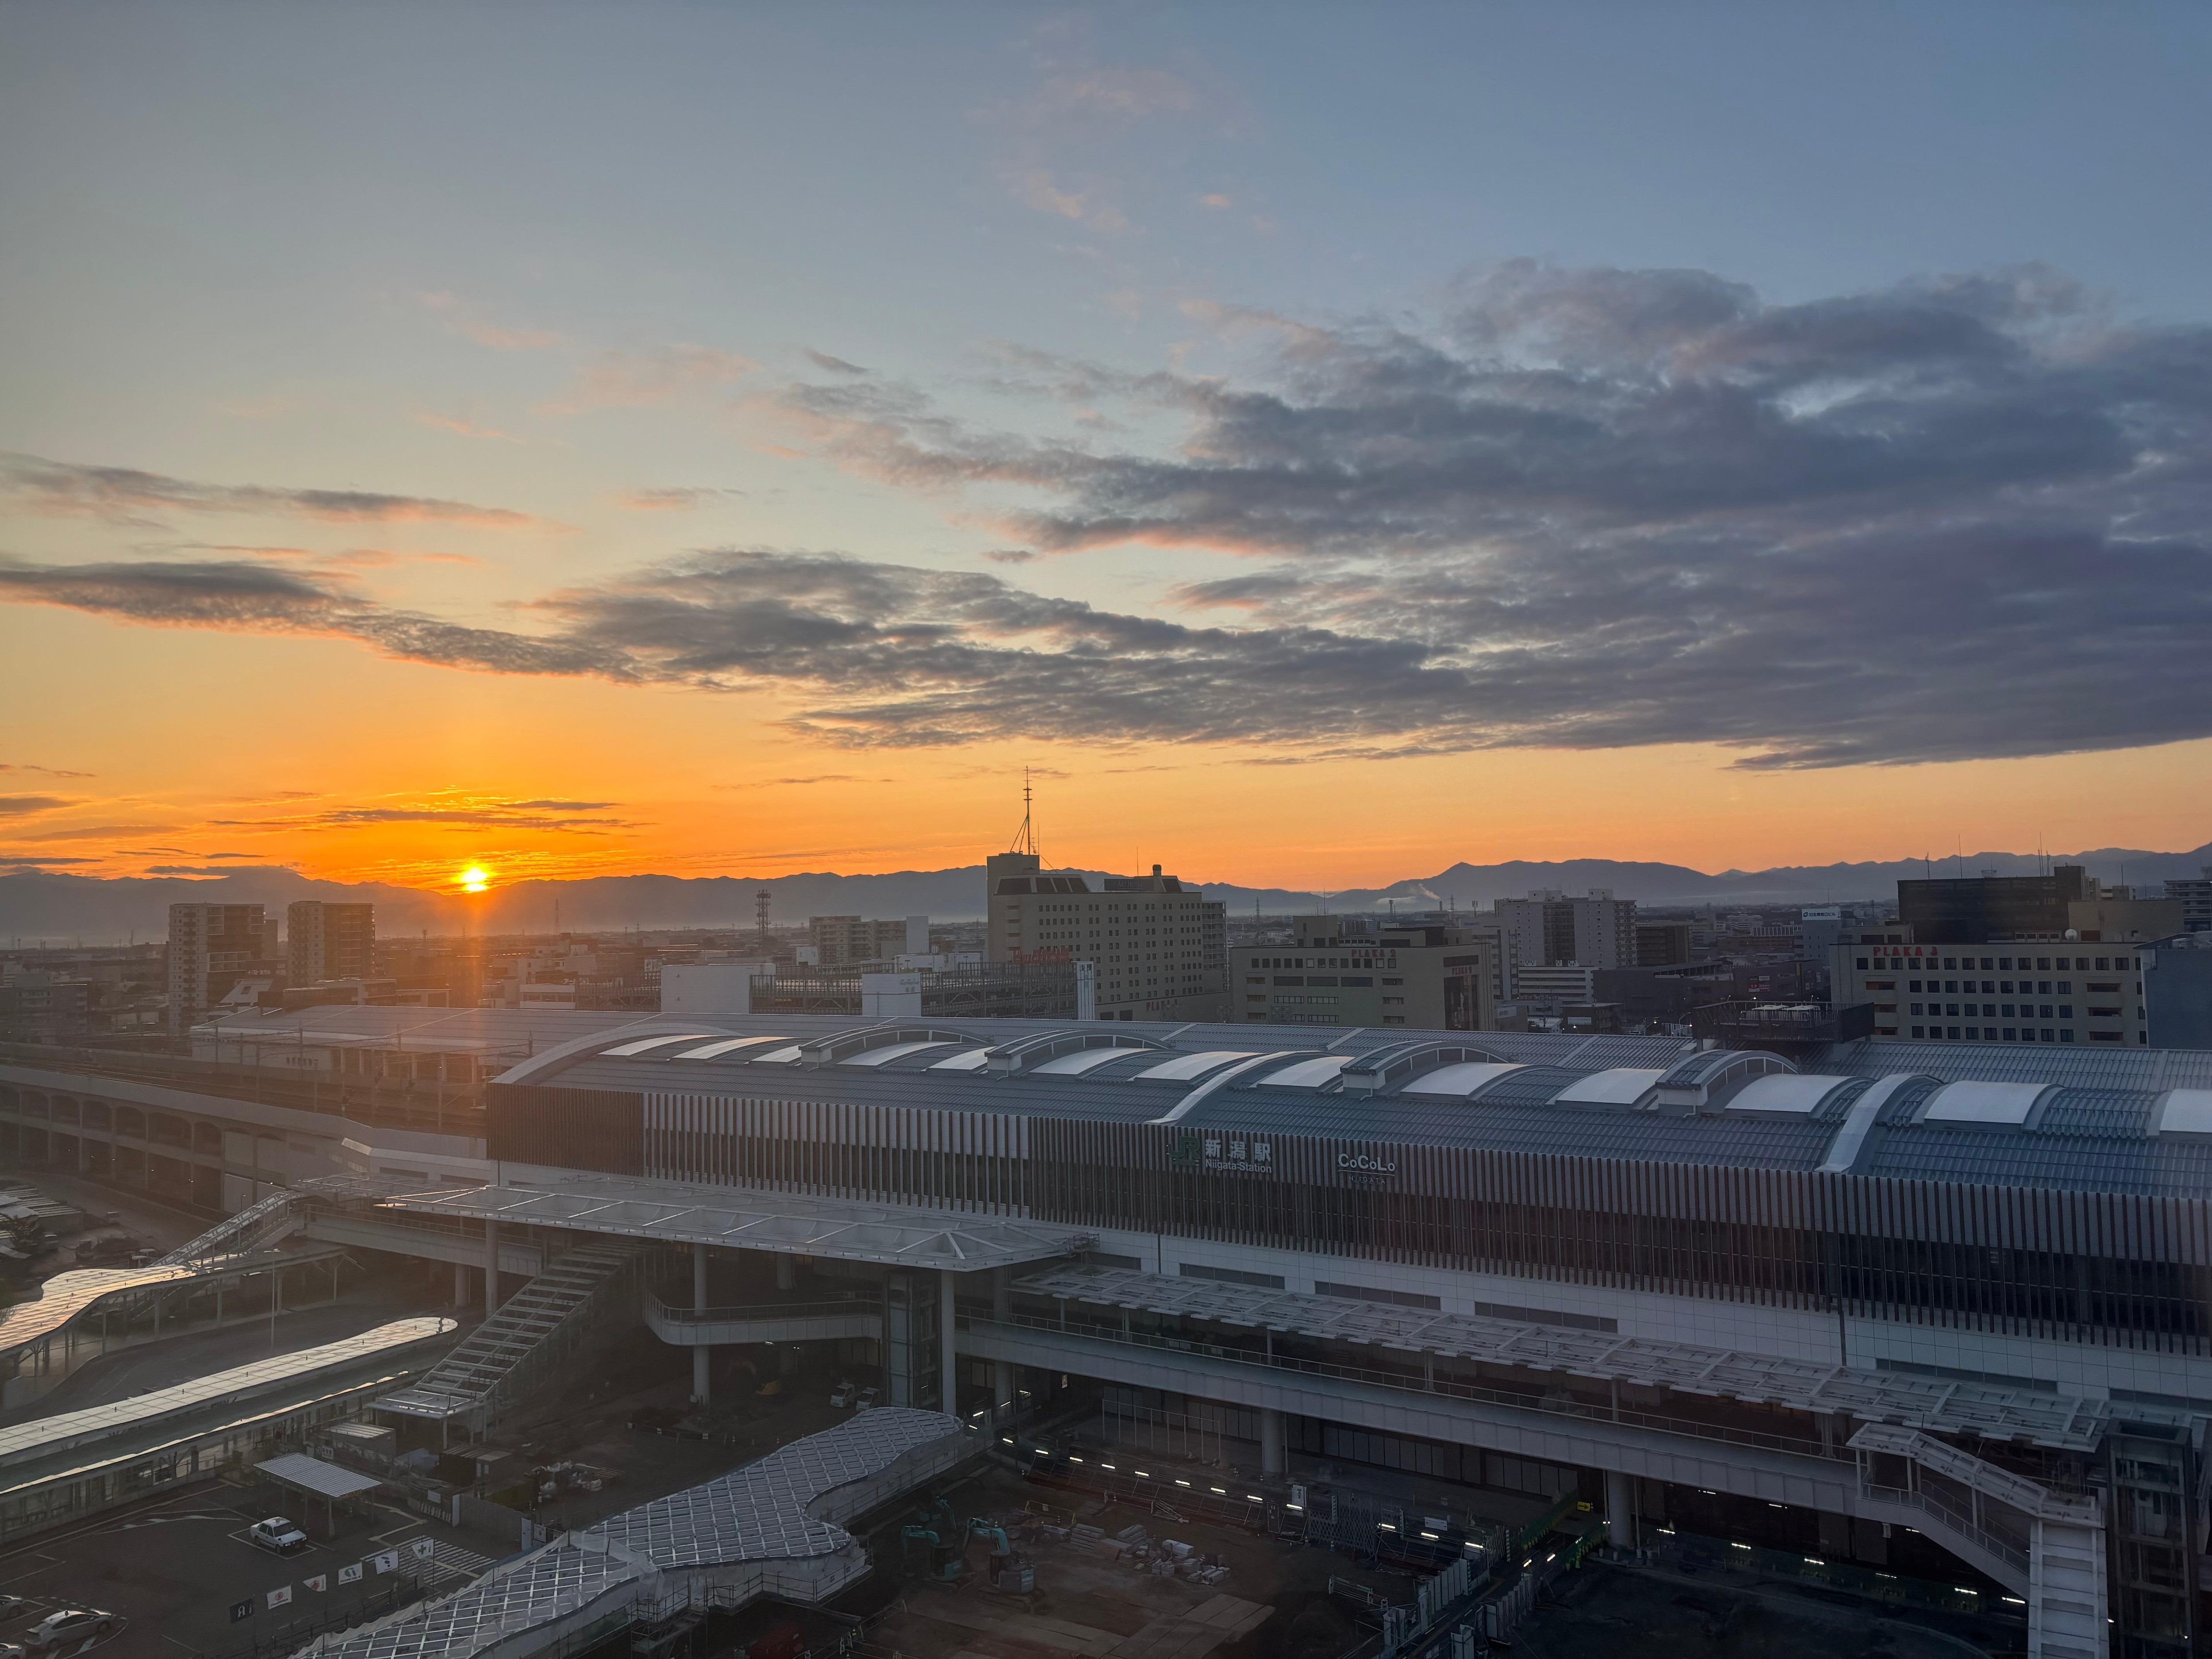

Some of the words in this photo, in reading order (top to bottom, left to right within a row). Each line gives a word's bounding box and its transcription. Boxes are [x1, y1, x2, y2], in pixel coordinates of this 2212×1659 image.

[1352, 949, 1385, 957] PLAKA
[1390, 949, 1397, 957] 2
[1874, 946, 1923, 956] PLAKA
[1930, 946, 1938, 956] 3
[1168, 1136, 1201, 1159] JR
[1205, 1139, 1271, 1162] 新潟駅
[1205, 1159, 1237, 1171] Niigata
[1239, 1162, 1272, 1174] Station
[1338, 1153, 1395, 1172] CoCoLo
[1349, 1175, 1386, 1184] NIIGATA
